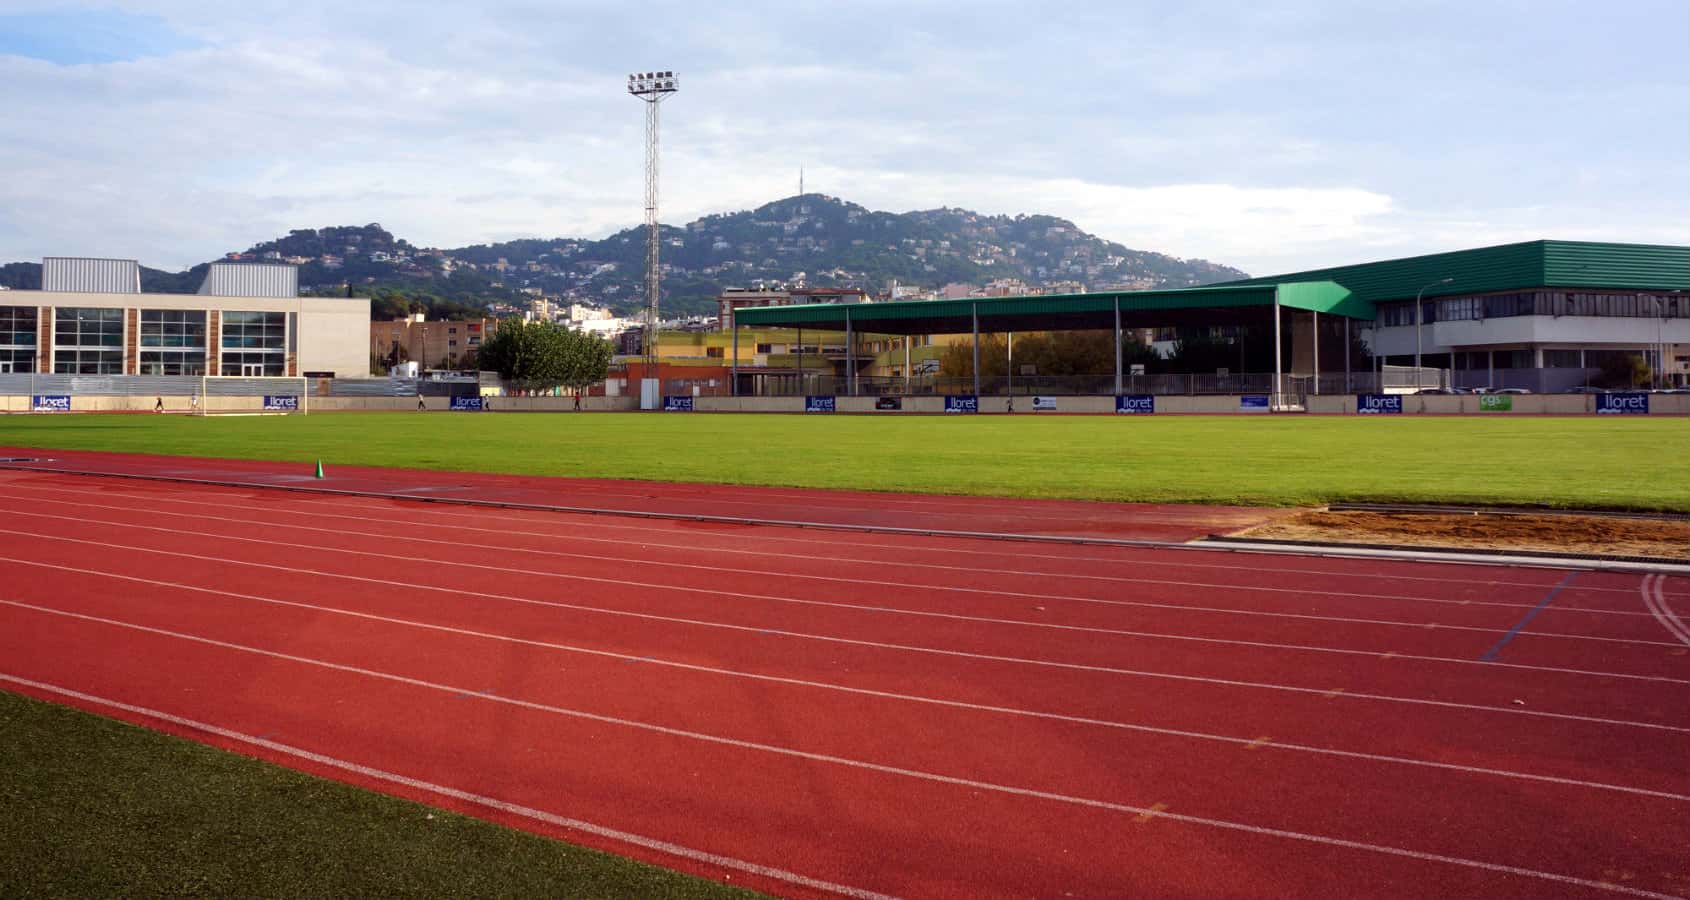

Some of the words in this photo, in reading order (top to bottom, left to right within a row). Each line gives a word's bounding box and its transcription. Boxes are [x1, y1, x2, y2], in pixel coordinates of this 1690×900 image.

[951, 397, 976, 408] lloret
[1123, 396, 1152, 408] lloret
[1366, 395, 1400, 408] lloret
[1606, 394, 1645, 408] lloret
